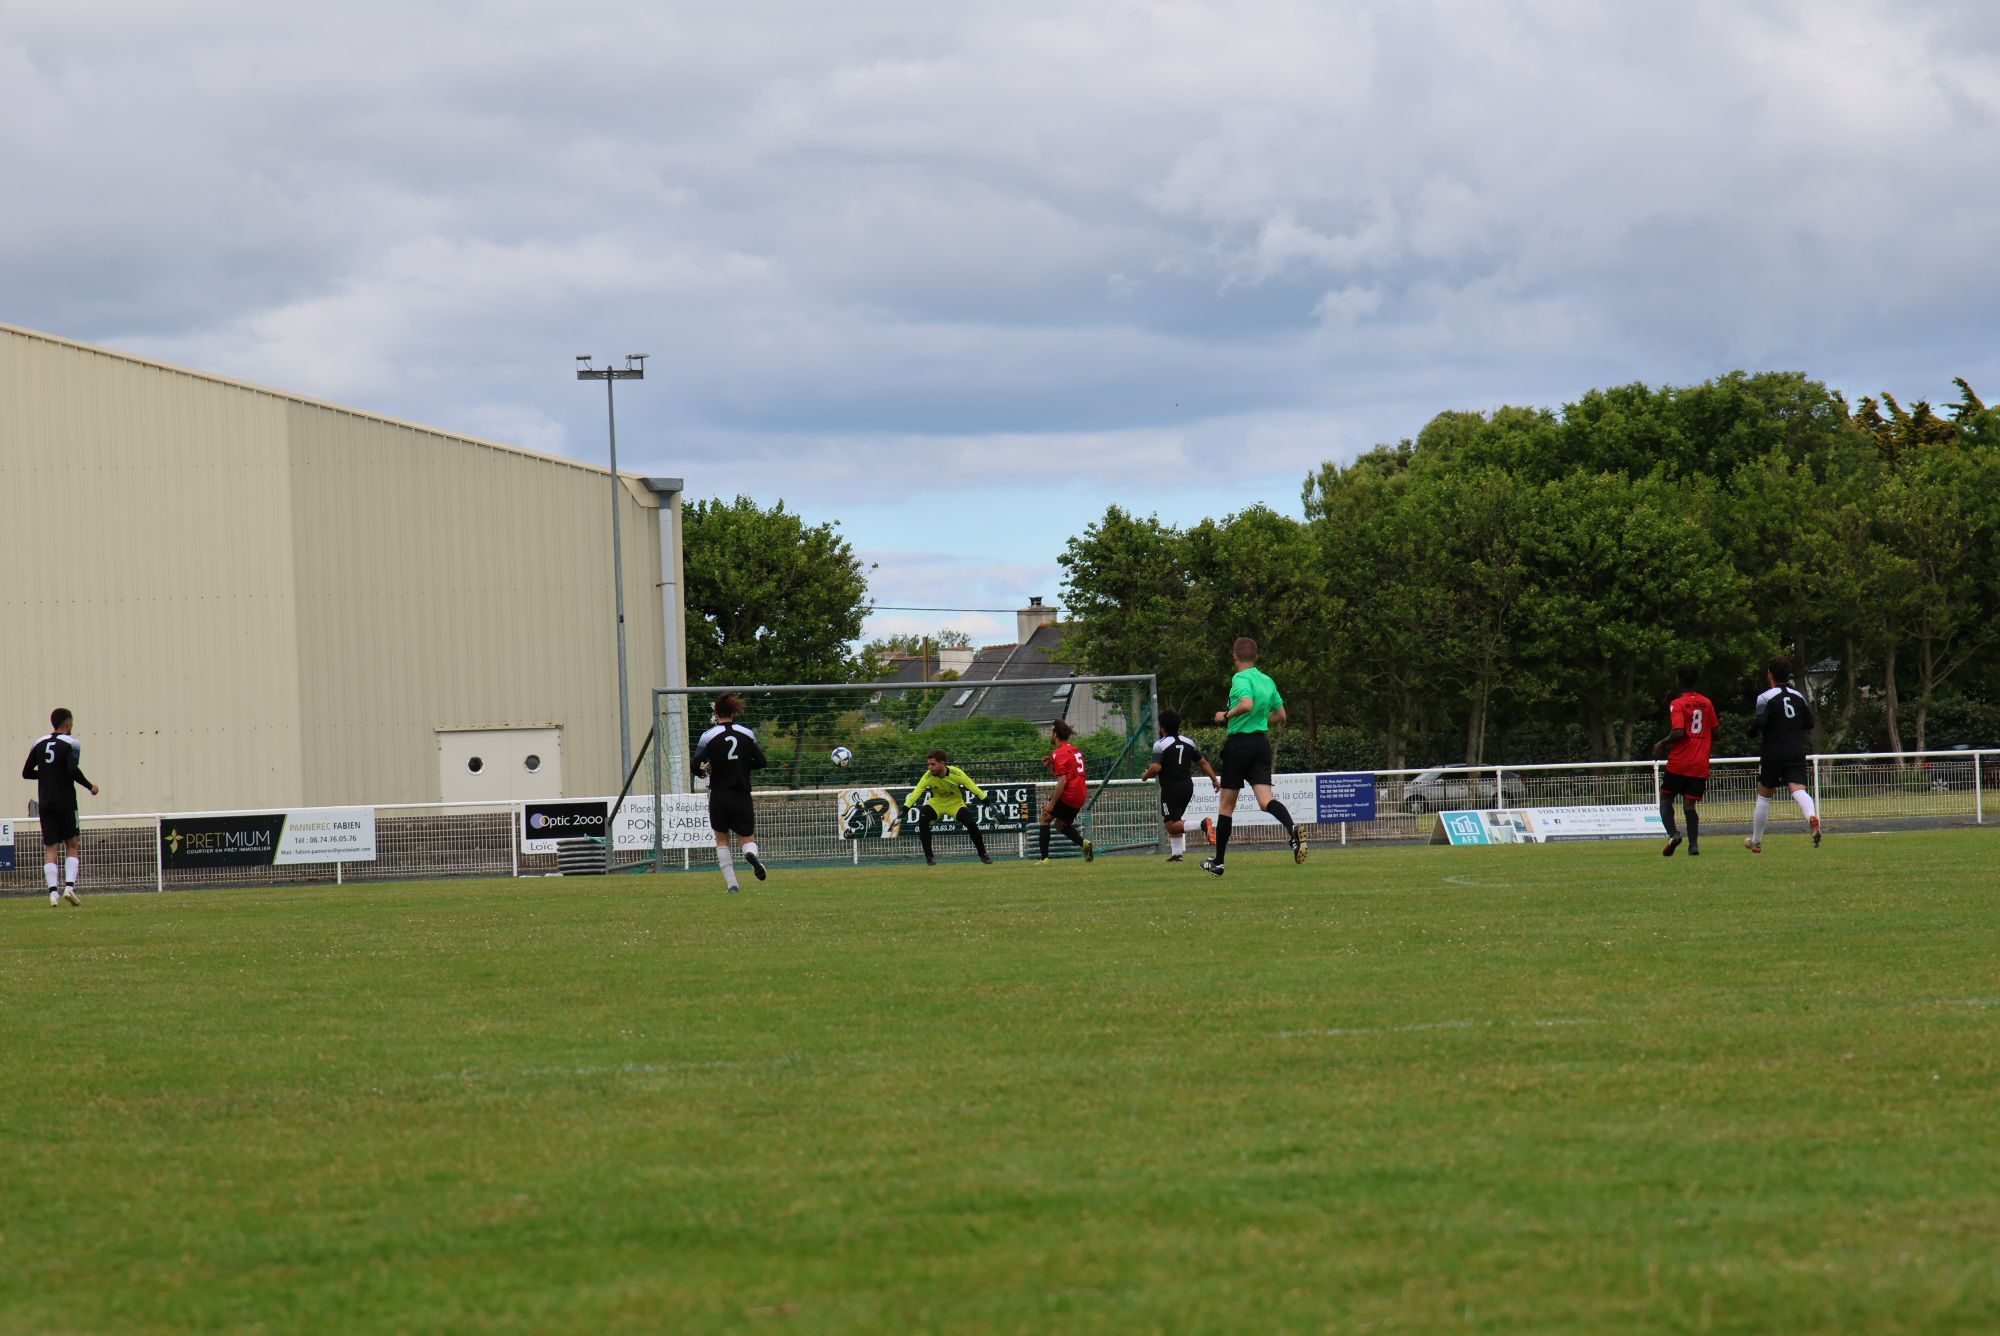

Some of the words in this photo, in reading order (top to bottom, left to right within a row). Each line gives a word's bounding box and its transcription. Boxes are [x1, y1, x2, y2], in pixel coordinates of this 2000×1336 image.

[1782, 696, 1796, 719] 6
[1690, 709, 1703, 734] 8
[45, 741, 57, 764] 5
[724, 735, 739, 760] 2
[1175, 744, 1184, 765] 7
[1074, 752, 1084, 773] 5
[1282, 790, 1290, 800] la
[1292, 789, 1314, 801] côte
[630, 803, 652, 813] Place
[1020, 803, 1029, 821] BZH
[333, 821, 361, 830] FABIEN
[540, 815, 571, 829] Optic
[573, 814, 604, 826] 2000
[186, 830, 270, 849] PRET'MIUM
[294, 836, 305, 844] Tél
[309, 834, 357, 843] 06.74.76.05.76
[530, 842, 554, 851] Loïc
[1461, 835, 1479, 844] AFB
